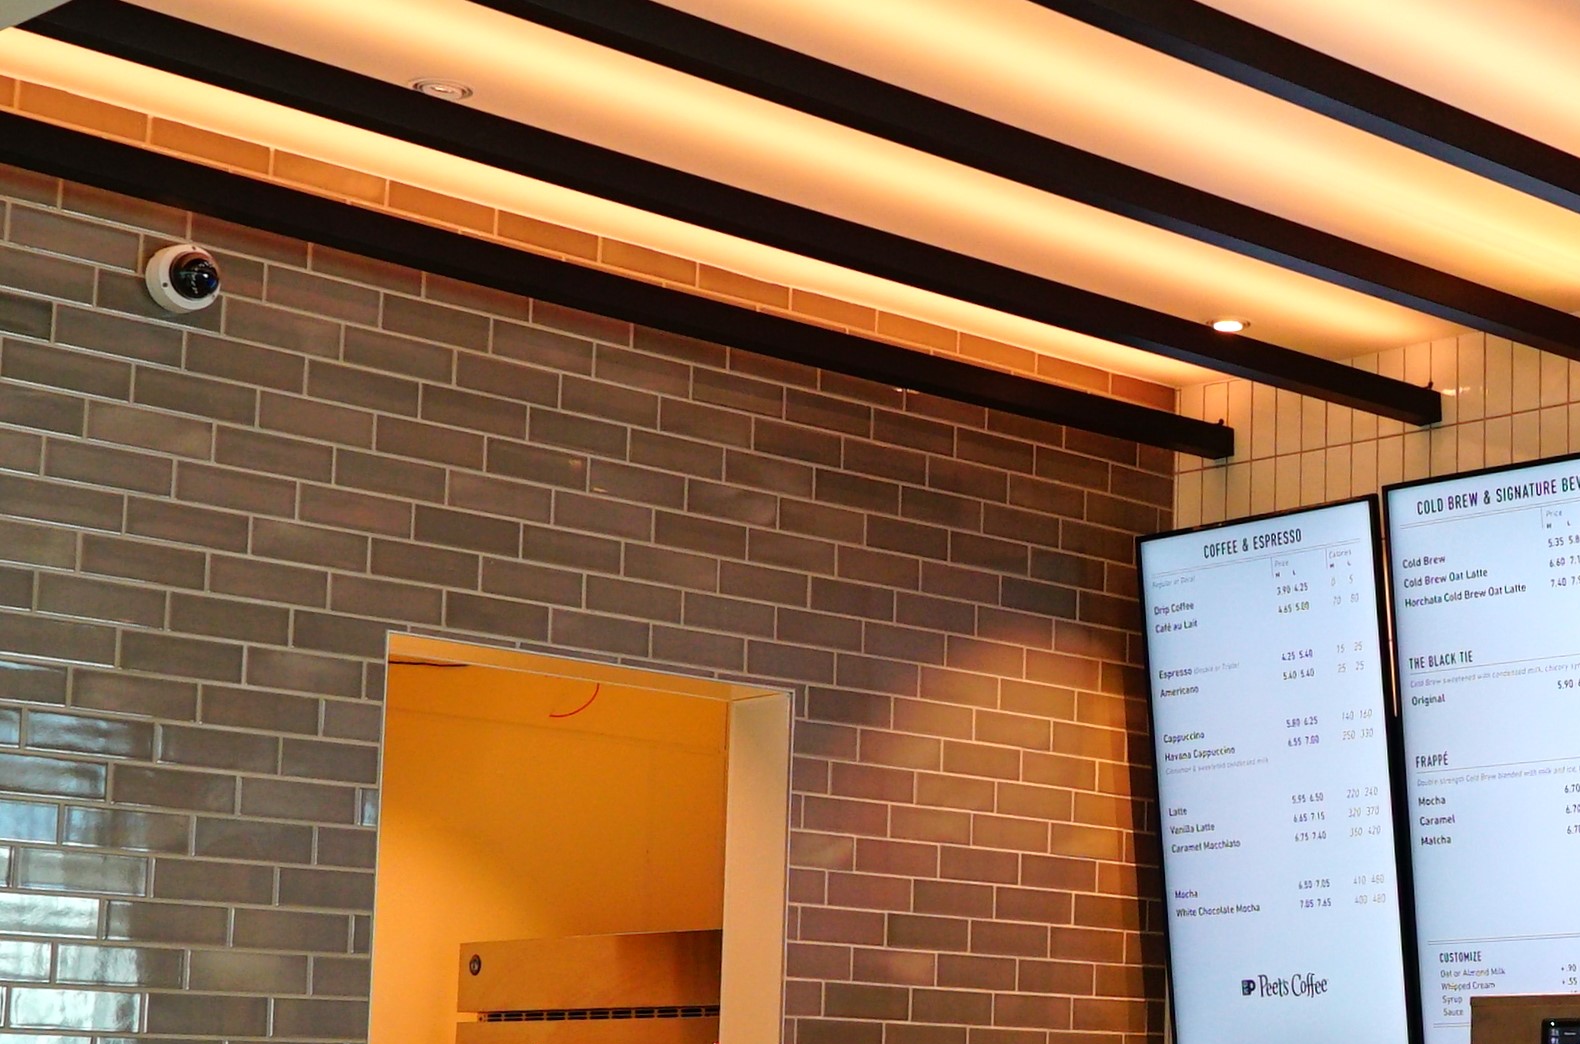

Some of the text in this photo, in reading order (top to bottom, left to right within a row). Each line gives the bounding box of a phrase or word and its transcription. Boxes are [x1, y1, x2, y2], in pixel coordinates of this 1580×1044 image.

[1417, 498, 1443, 515] COLD
[1448, 492, 1478, 510] BREW
[1483, 490, 1490, 505] &
[1496, 479, 1557, 503] SIGNATURE
[1203, 528, 1301, 559] COFFEE & ESPRESSO
[1402, 556, 1445, 569] Cold Brew
[1403, 569, 1488, 589] Cold Brew Oat Latte
[1404, 584, 1526, 608] Horchata Cold Brew Oat Latte
[1409, 650, 1473, 670] THE BLACK TIE
[1411, 694, 1445, 707] Original
[1415, 751, 1448, 768] FRAPPÉ
[1418, 796, 1446, 806] Mocha
[1419, 814, 1455, 826] Caramel
[1421, 835, 1451, 846] Matcha
[1439, 951, 1481, 963] CUSTOMIZE
[1291, 972, 1327, 998] Coffee
